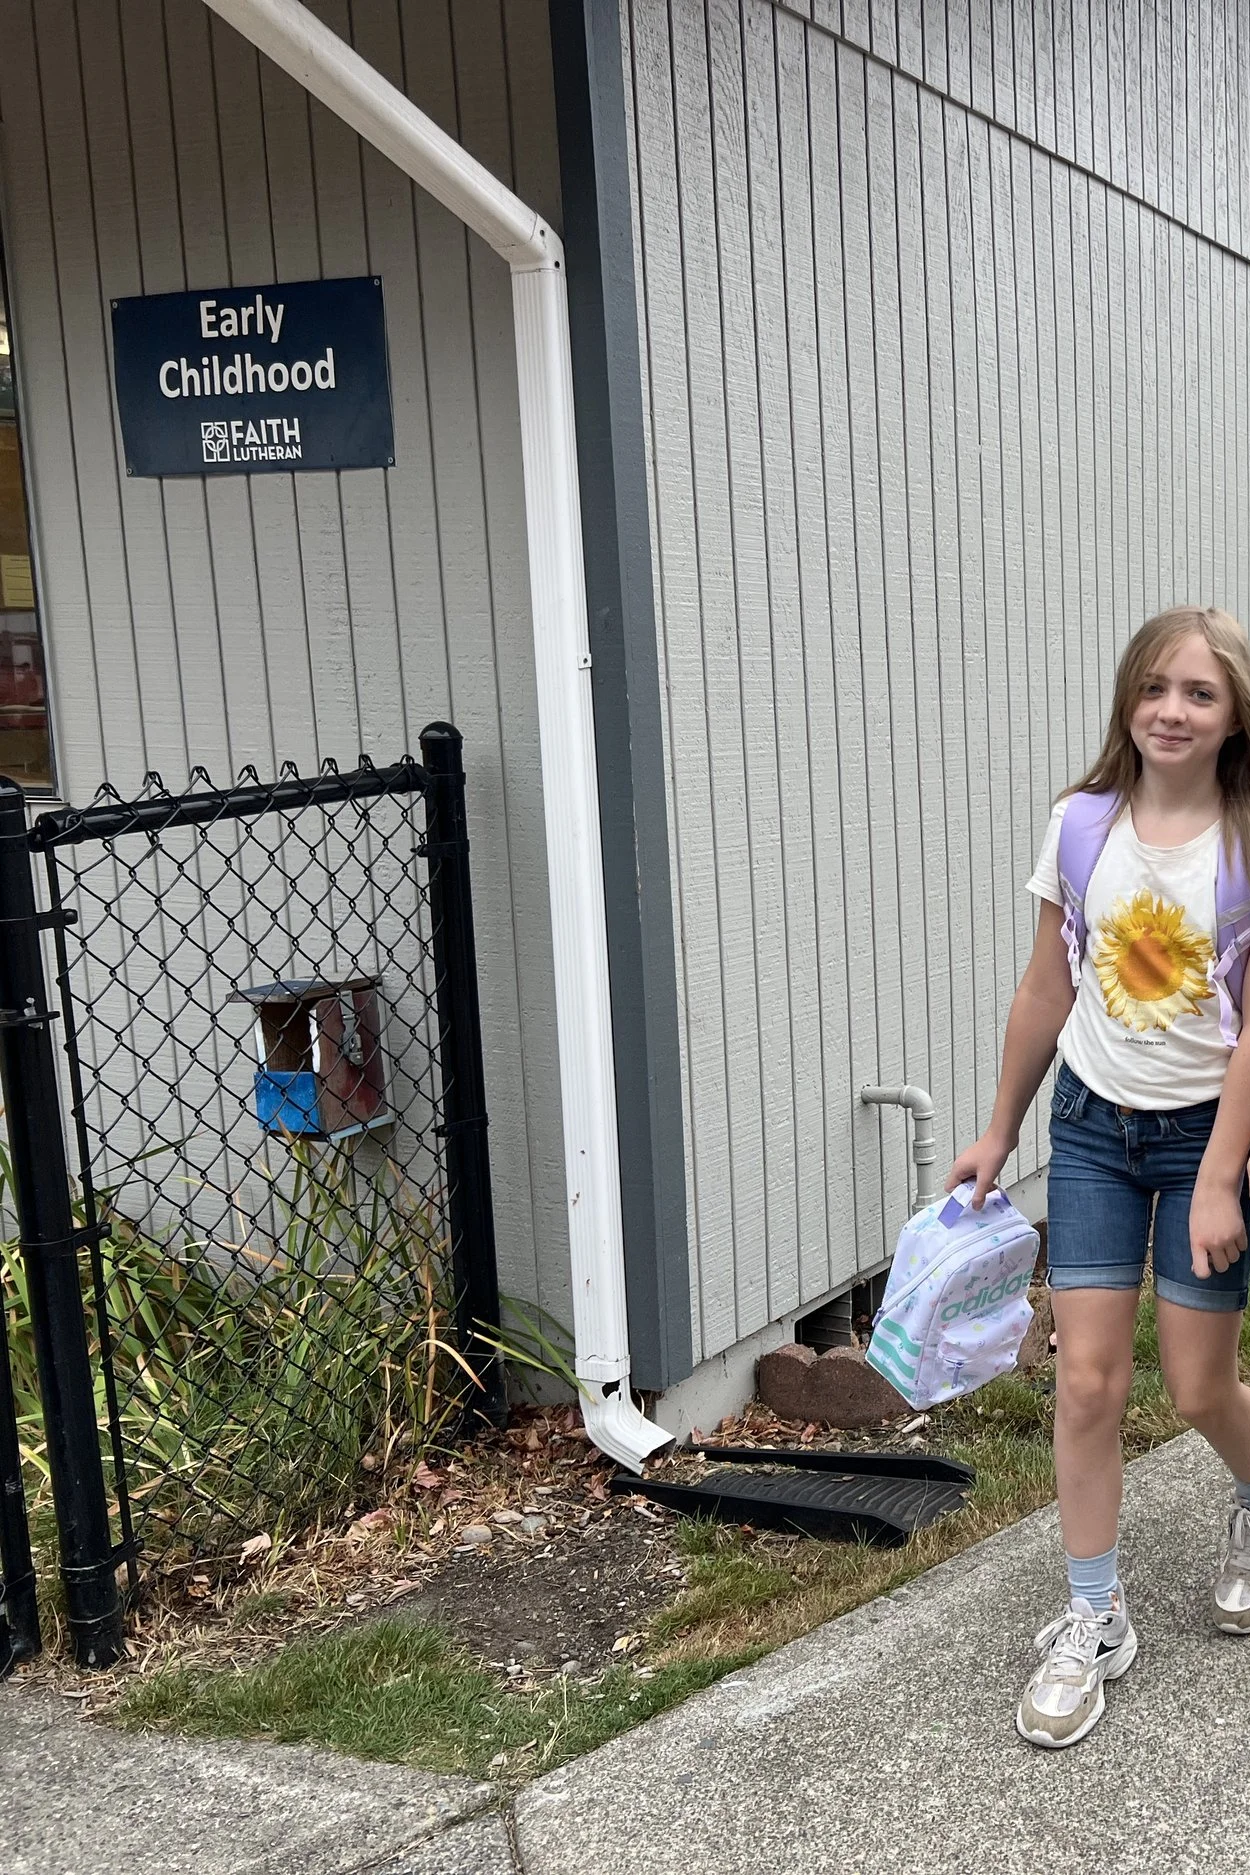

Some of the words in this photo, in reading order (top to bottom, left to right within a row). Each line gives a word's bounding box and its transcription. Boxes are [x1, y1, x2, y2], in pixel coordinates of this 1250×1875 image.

[200, 294, 284, 343] Early
[159, 347, 336, 398] Childhood
[230, 417, 301, 445] FAITH
[233, 445, 302, 462] LUTHERAN
[940, 1267, 1034, 1322] adidas
